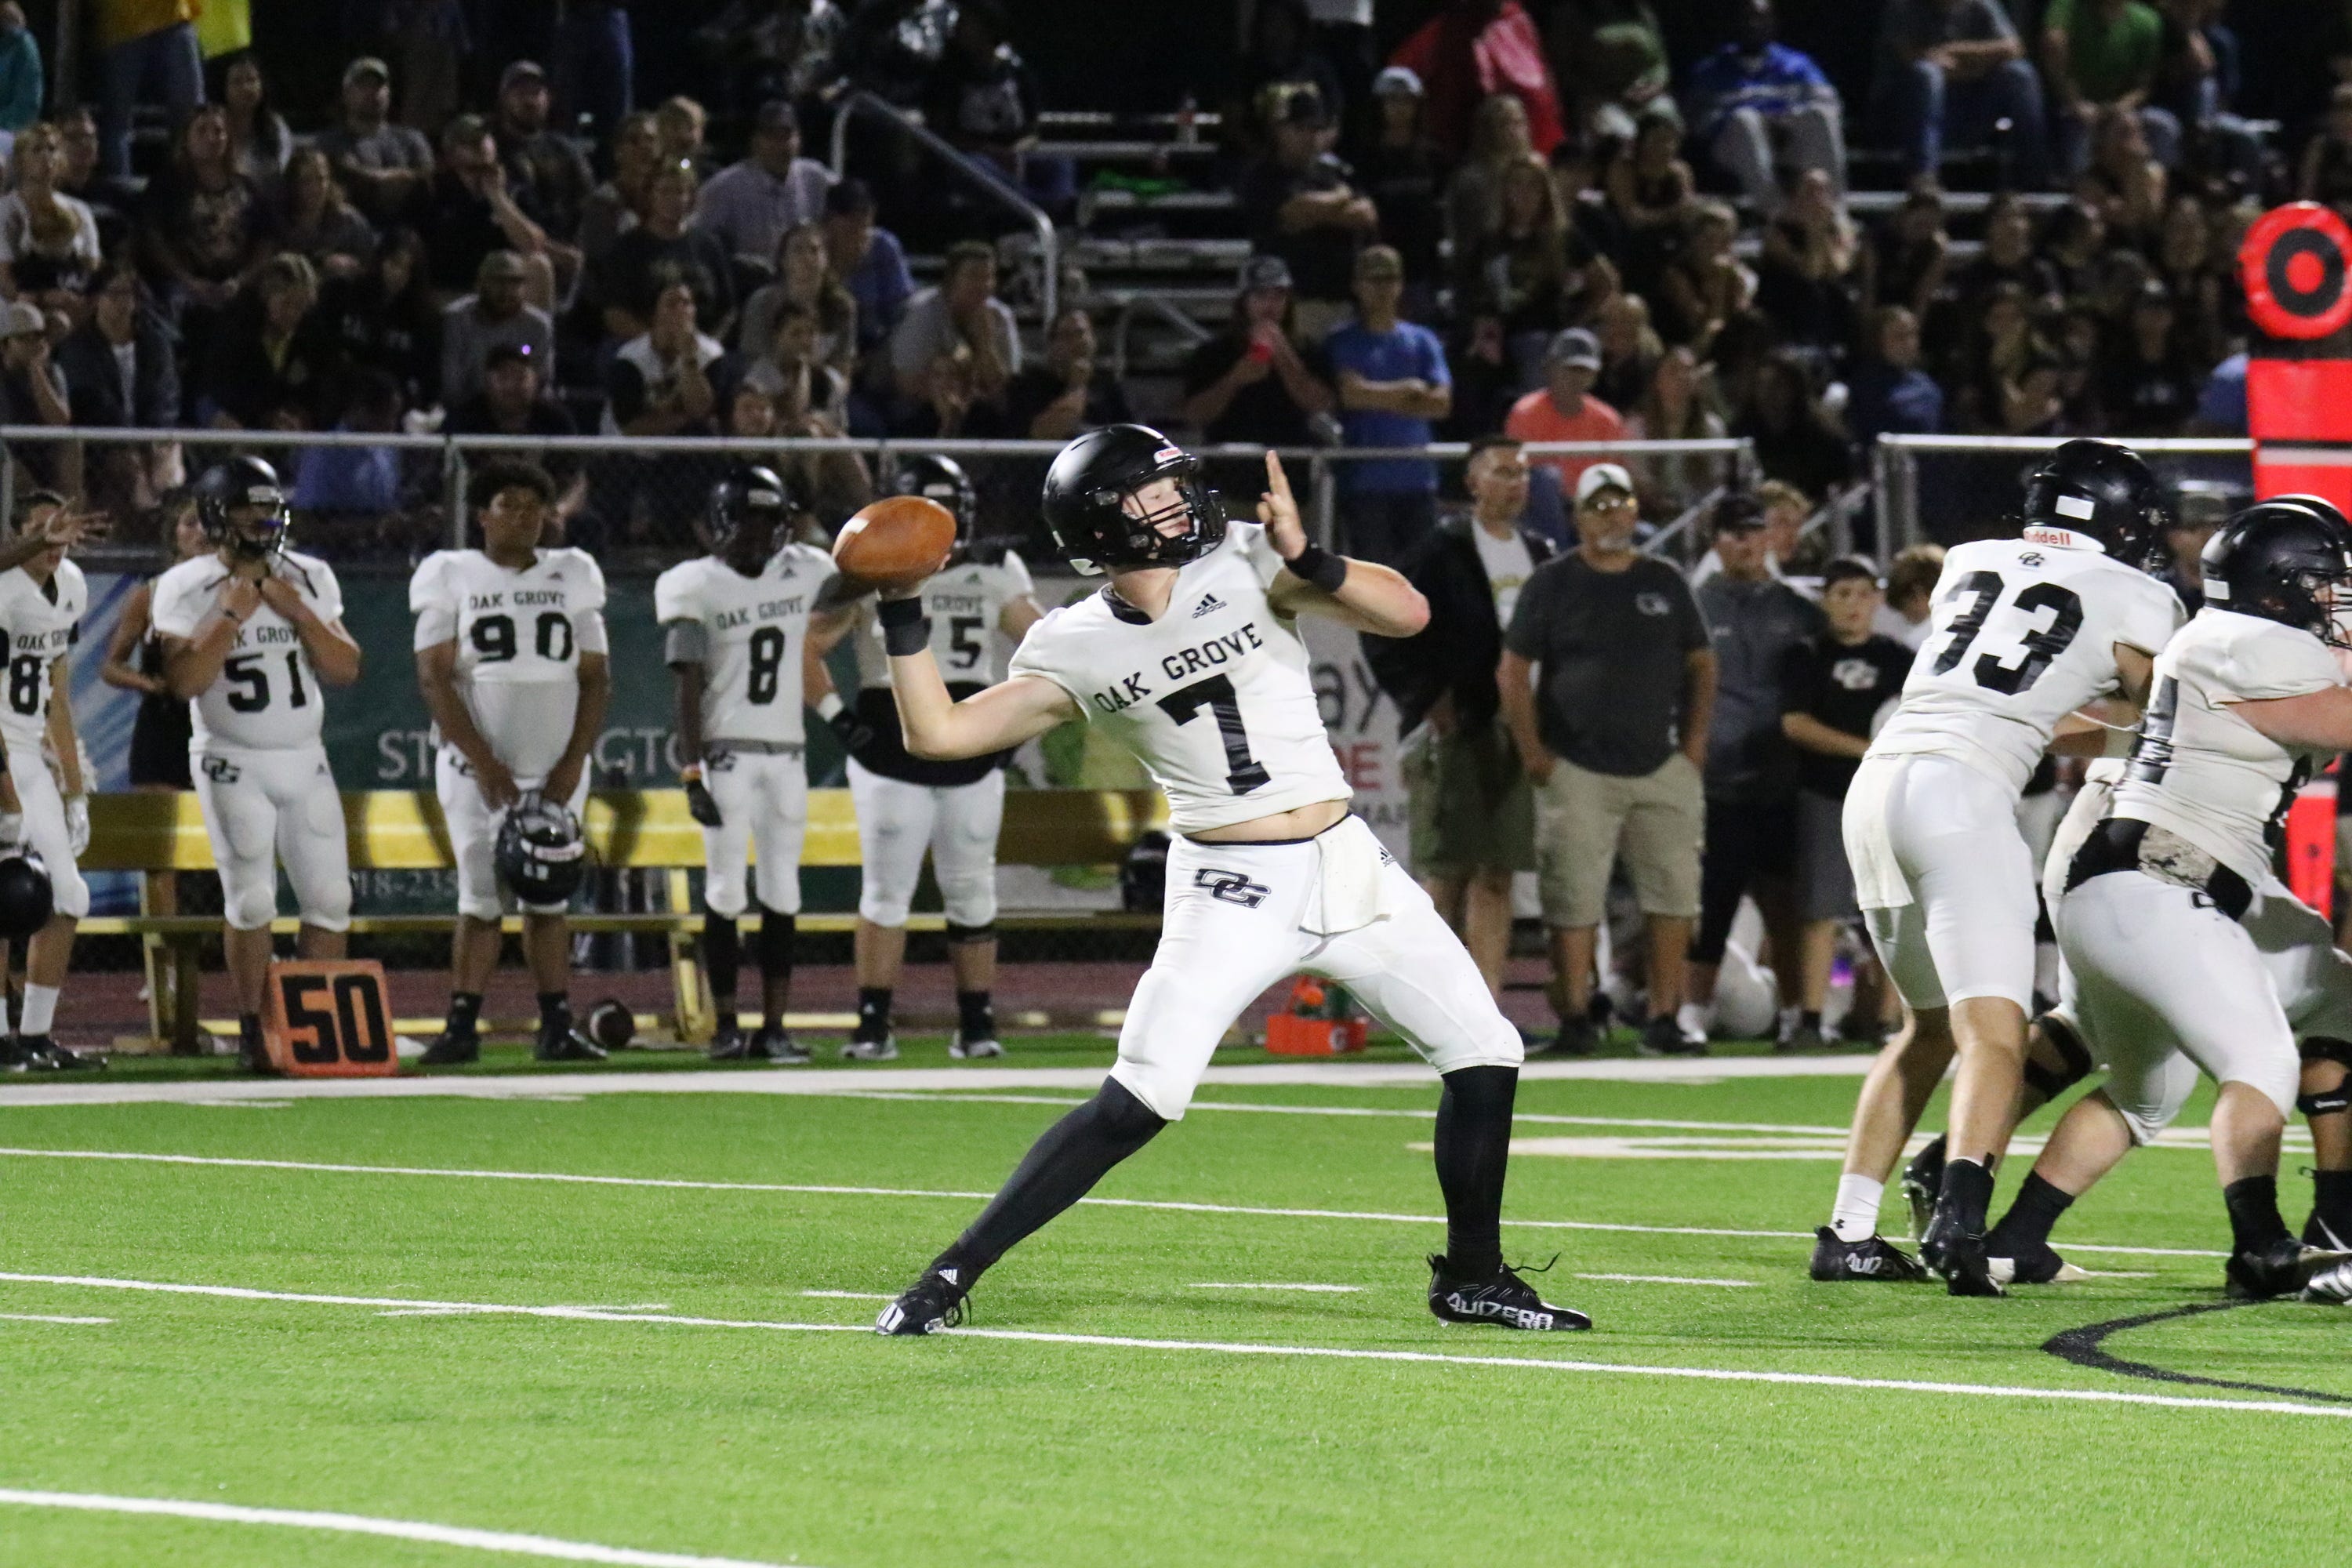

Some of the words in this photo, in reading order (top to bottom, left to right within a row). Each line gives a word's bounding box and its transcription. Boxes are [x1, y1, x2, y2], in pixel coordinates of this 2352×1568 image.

[17, 633, 45, 650] OAK
[470, 612, 573, 662] 90
[716, 608, 750, 628] OAK
[758, 595, 803, 620] GROVE
[1932, 574, 2084, 696] 33
[224, 651, 307, 713] 51
[748, 626, 786, 705] 8
[1094, 672, 1151, 713] OAK
[1161, 622, 1263, 681] GROVE
[1156, 673, 1272, 796] 7
[281, 975, 388, 1063] 50
